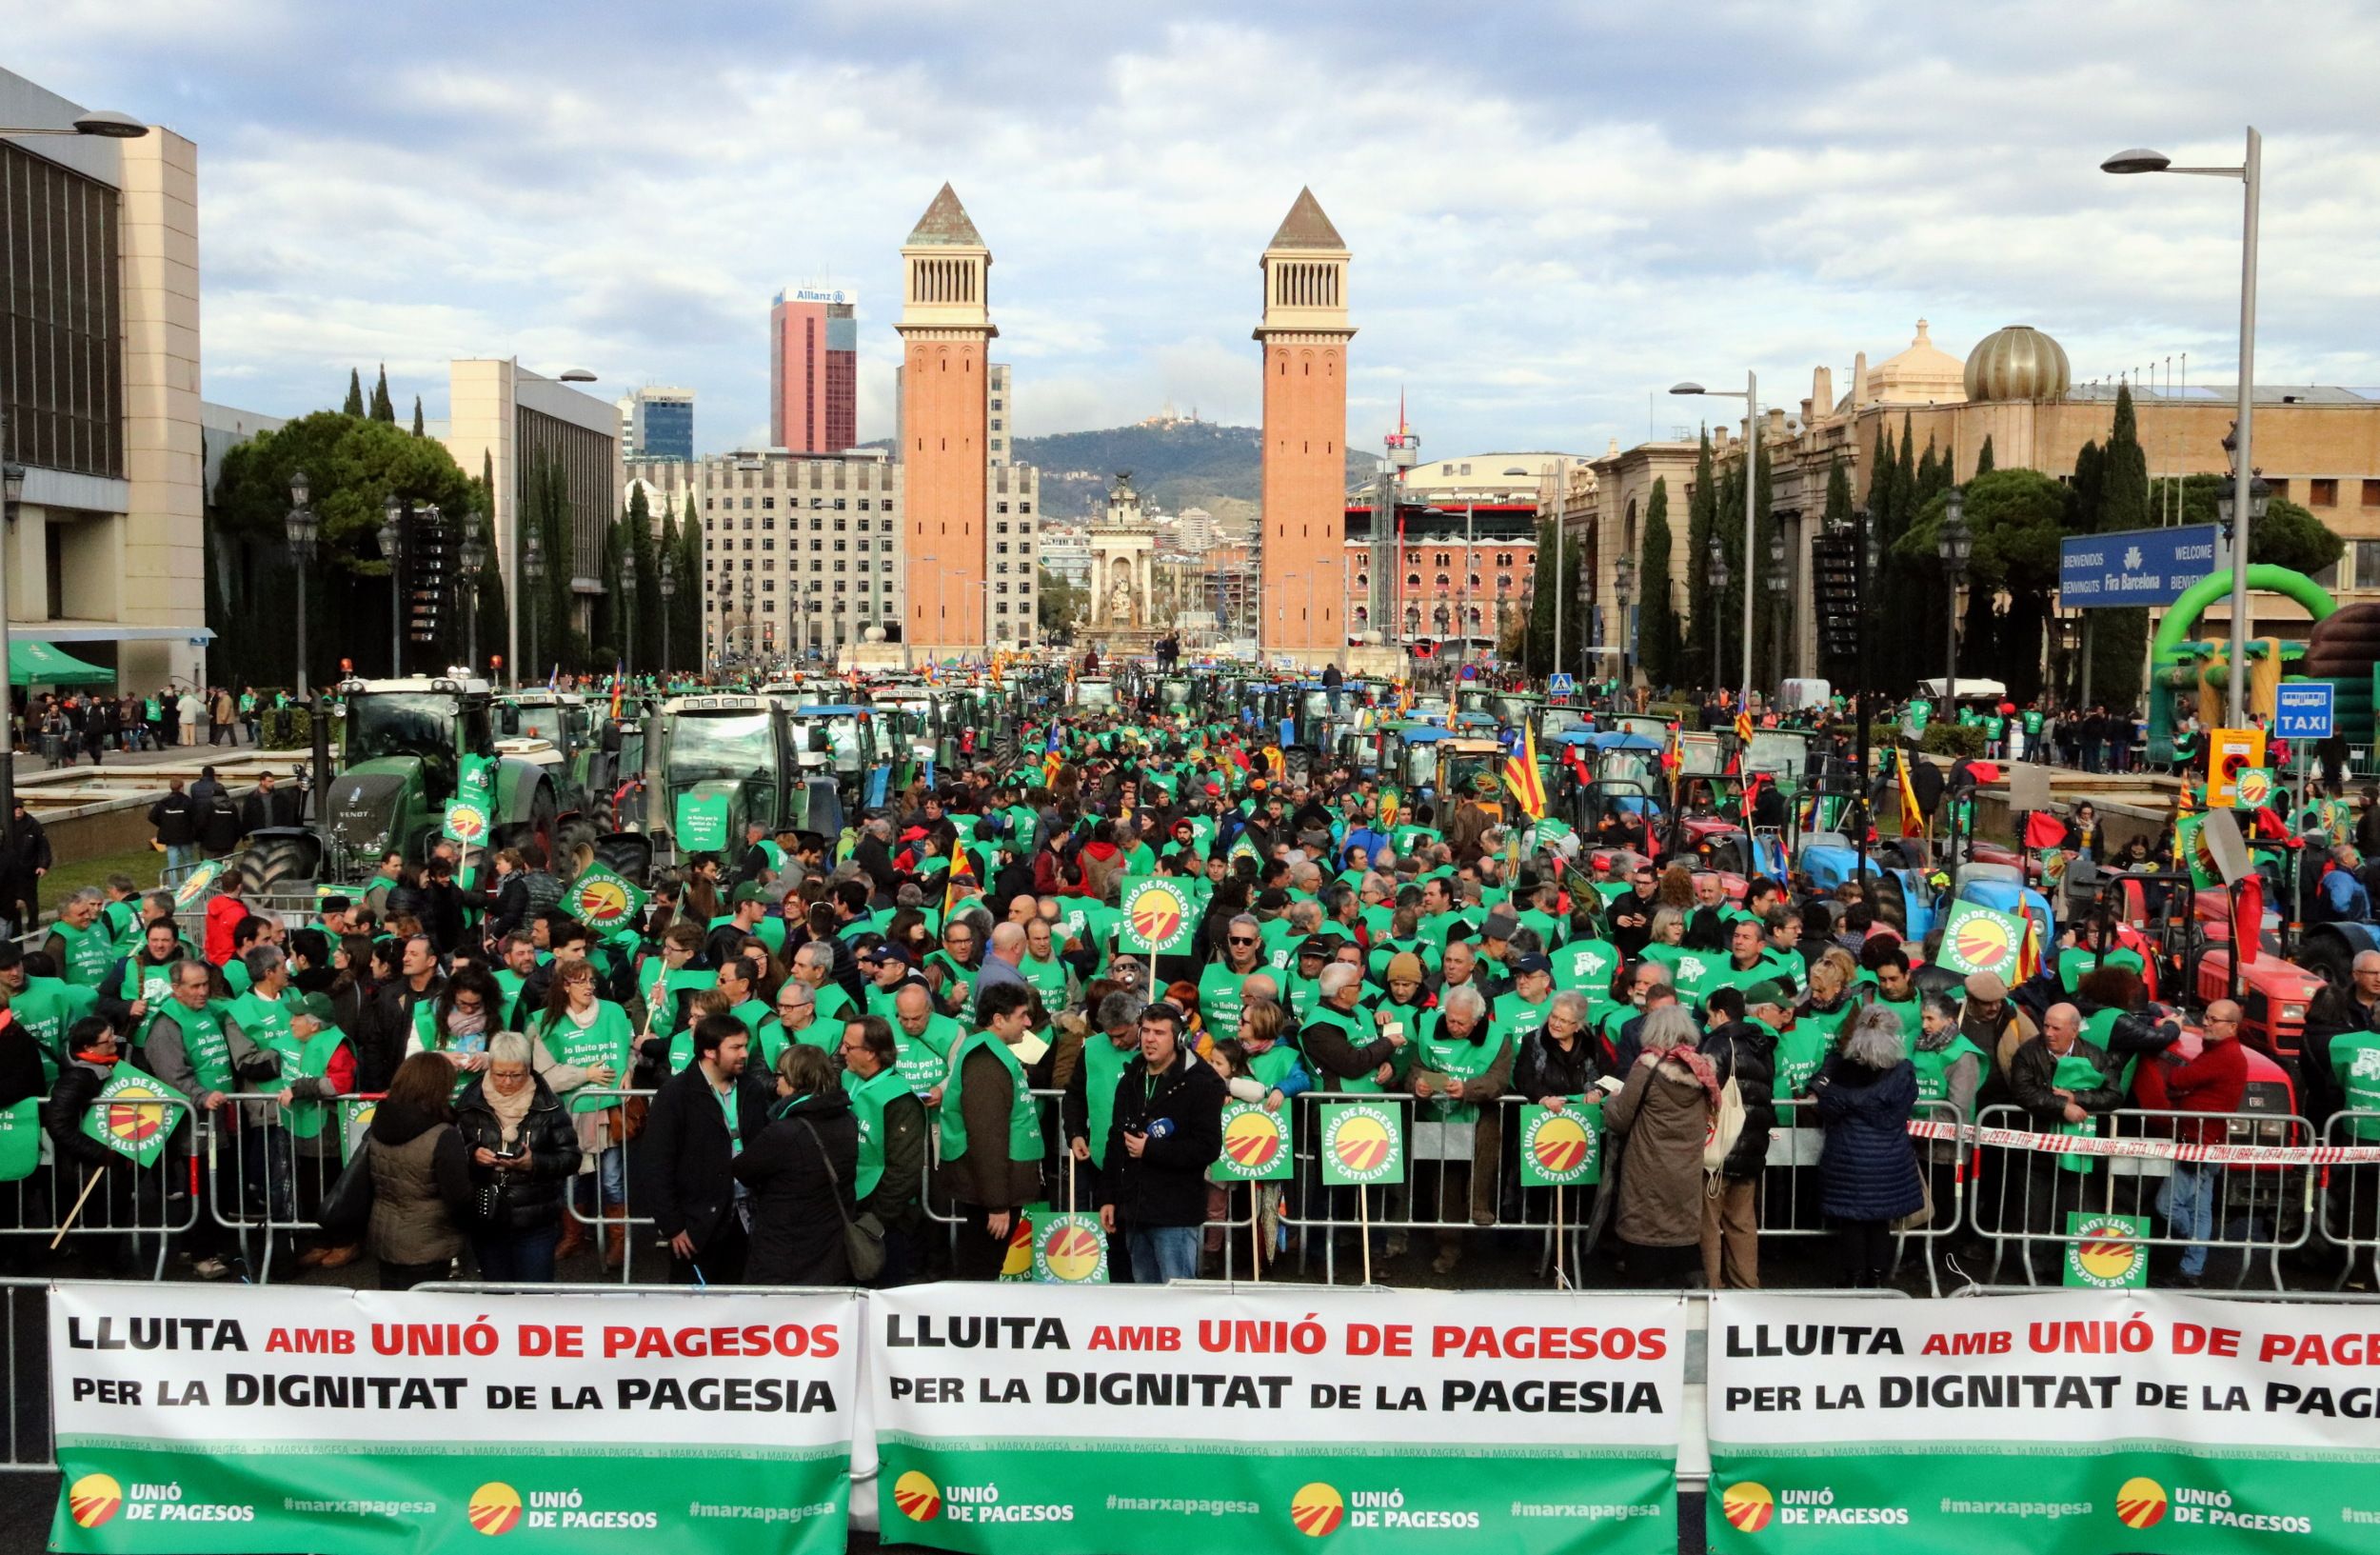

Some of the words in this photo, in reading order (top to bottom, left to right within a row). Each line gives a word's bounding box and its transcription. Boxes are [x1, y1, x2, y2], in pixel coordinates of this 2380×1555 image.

[797, 290, 831, 301] Allianz
[2064, 553, 2103, 568] BIENVENIDOS
[2174, 545, 2212, 560] WELCOME
[2063, 580, 2100, 594] BENVINGUTS
[2105, 573, 2119, 591] Fira
[2121, 572, 2160, 590] Barcelona
[2281, 716, 2326, 730] TAXI
[572, 889, 582, 901] DE
[578, 873, 601, 889] UNIÓ
[616, 880, 634, 916] PAGESOS
[1123, 887, 1140, 916] UNIÓ
[1140, 880, 1154, 891] DE
[1156, 880, 1189, 918] PAGESOS
[573, 903, 626, 927] CATLUNYA
[1123, 920, 1135, 935] DE
[1949, 913, 1970, 936] UNIÓ
[1971, 909, 1987, 918] DE
[1987, 911, 2017, 952] PAGESOS
[1947, 939, 1957, 953] DE
[1212, 1010, 1240, 1021] dignitat
[575, 1044, 597, 1052] lluito
[609, 1041, 618, 1049] la
[566, 1054, 600, 1066] dignitat
[897, 1060, 918, 1069] lluito
[919, 1060, 934, 1069] per
[131, 1077, 149, 1087] DE
[922, 1070, 933, 1079] de
[1231, 1104, 1247, 1116] DE
[861, 1120, 870, 1131] la
[1325, 1117, 1341, 1146] UNIÓ
[1340, 1107, 1357, 1121] DE
[1359, 1106, 1398, 1145] PAGESOS
[1524, 1118, 1541, 1147] UNIÓ
[2074, 1139, 2095, 1152] ZONA
[2095, 1141, 2118, 1153] LIBRE
[2210, 1146, 2231, 1160] ZONA
[2231, 1147, 2255, 1160] LIBRE
[1226, 1144, 1289, 1177] CATALUNYA
[1326, 1150, 1339, 1166] DE
[1338, 1147, 1399, 1181] CATALUNYA
[1525, 1151, 1537, 1167] DE
[1536, 1149, 1597, 1182] CATALUNYA
[1036, 1216, 1098, 1248] CATLUNYA
[1097, 1231, 1108, 1248] DE
[1092, 1250, 1108, 1281] UNIÓ
[2069, 1248, 2107, 1287] PAGESOS
[2125, 1253, 2144, 1281] UNIÓ
[2109, 1277, 2126, 1287] DE
[68, 1316, 248, 1351] LLUITA
[265, 1326, 356, 1354] AMB
[371, 1315, 499, 1356] UNIÓ
[518, 1325, 583, 1358] DE
[603, 1324, 840, 1358] PAGESOS
[886, 1314, 1071, 1350] LLUITA
[1087, 1326, 1181, 1351] AMB
[1199, 1313, 1326, 1354] UNIÓ
[1346, 1324, 1413, 1357] DE
[1432, 1326, 1667, 1360] PAGESOS
[1726, 1325, 1904, 1358] LLUITA
[1921, 1330, 2012, 1356] AMB
[2029, 1311, 2153, 1354] UNIÓ
[2172, 1322, 2241, 1358] DE
[72, 1377, 142, 1405] PER
[157, 1380, 210, 1406] LA
[226, 1373, 467, 1409] DIGNITAT
[486, 1385, 537, 1409] DE
[551, 1386, 604, 1409] LA
[617, 1378, 837, 1413] PAGESIA
[890, 1376, 964, 1404] PER
[980, 1378, 1031, 1404] LA
[1045, 1372, 1292, 1408] DIGNITAT
[1310, 1385, 1360, 1409] DE
[1376, 1386, 1427, 1411] LA
[1441, 1380, 1663, 1414] PAGESIA
[1726, 1386, 1801, 1411] PER
[1815, 1385, 1865, 1409] LA
[1879, 1375, 2121, 1408] DIGNITAT
[2136, 1382, 2188, 1410] DE
[2203, 1386, 2251, 1411] LA
[997, 1441, 1032, 1452] MARXA
[1034, 1442, 1070, 1452] PAGESA
[1736, 1448, 1769, 1458] MARXA
[1773, 1448, 1808, 1458] PAGESA
[130, 1482, 181, 1501] UNIÓ
[530, 1488, 582, 1507] UNIÓ
[946, 1483, 999, 1504] UNIÓ
[1351, 1487, 1403, 1508] UNIÓ
[1781, 1487, 1834, 1505] UNIÓ
[2174, 1487, 2231, 1506] UNIÓ
[127, 1503, 153, 1520] DE
[160, 1505, 254, 1521] PAGESOS
[284, 1497, 436, 1516] #marxapagesa
[688, 1500, 835, 1524] #marxapagesa
[1106, 1494, 1259, 1515] #marxapagesa
[1511, 1501, 1660, 1521] #marxapagesa
[1940, 1497, 2092, 1518] #marxapagesa
[528, 1511, 557, 1527] DE
[562, 1511, 657, 1528] PAGESOS
[948, 1505, 973, 1523] DE
[980, 1505, 1074, 1524] PAGESOS
[1351, 1511, 1379, 1527] DE
[1384, 1511, 1479, 1529] PAGESOS
[1781, 1507, 1808, 1524] DE
[1814, 1507, 1909, 1525] PAGESOS
[2174, 1505, 2204, 1525] DE
[2209, 1508, 2311, 1534] PAGESOS
